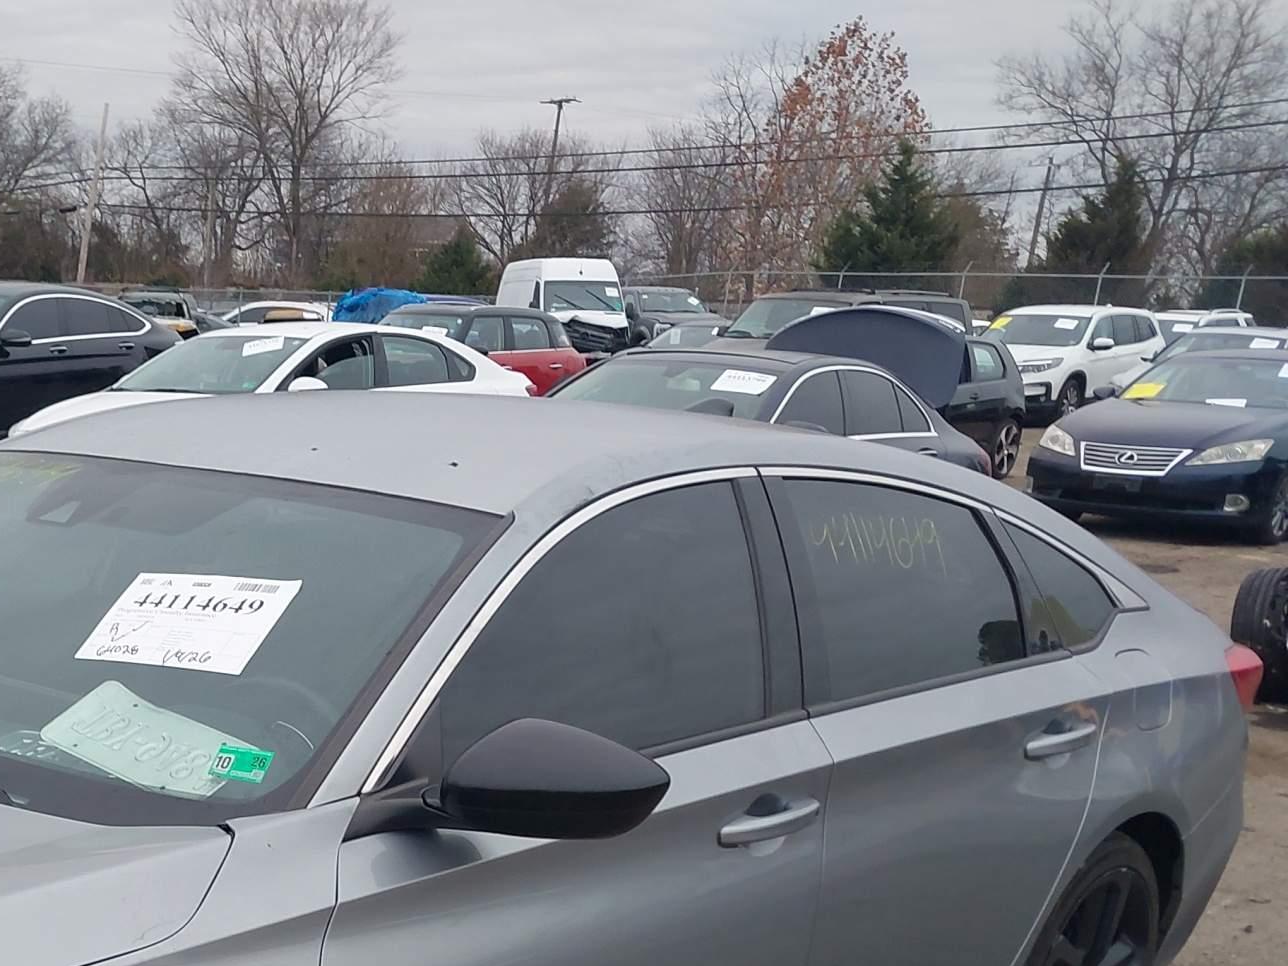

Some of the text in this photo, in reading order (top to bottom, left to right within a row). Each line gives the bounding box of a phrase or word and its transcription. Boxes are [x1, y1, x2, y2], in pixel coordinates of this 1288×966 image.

[134, 592, 264, 614] 44114649
[215, 756, 268, 769] 10 26
